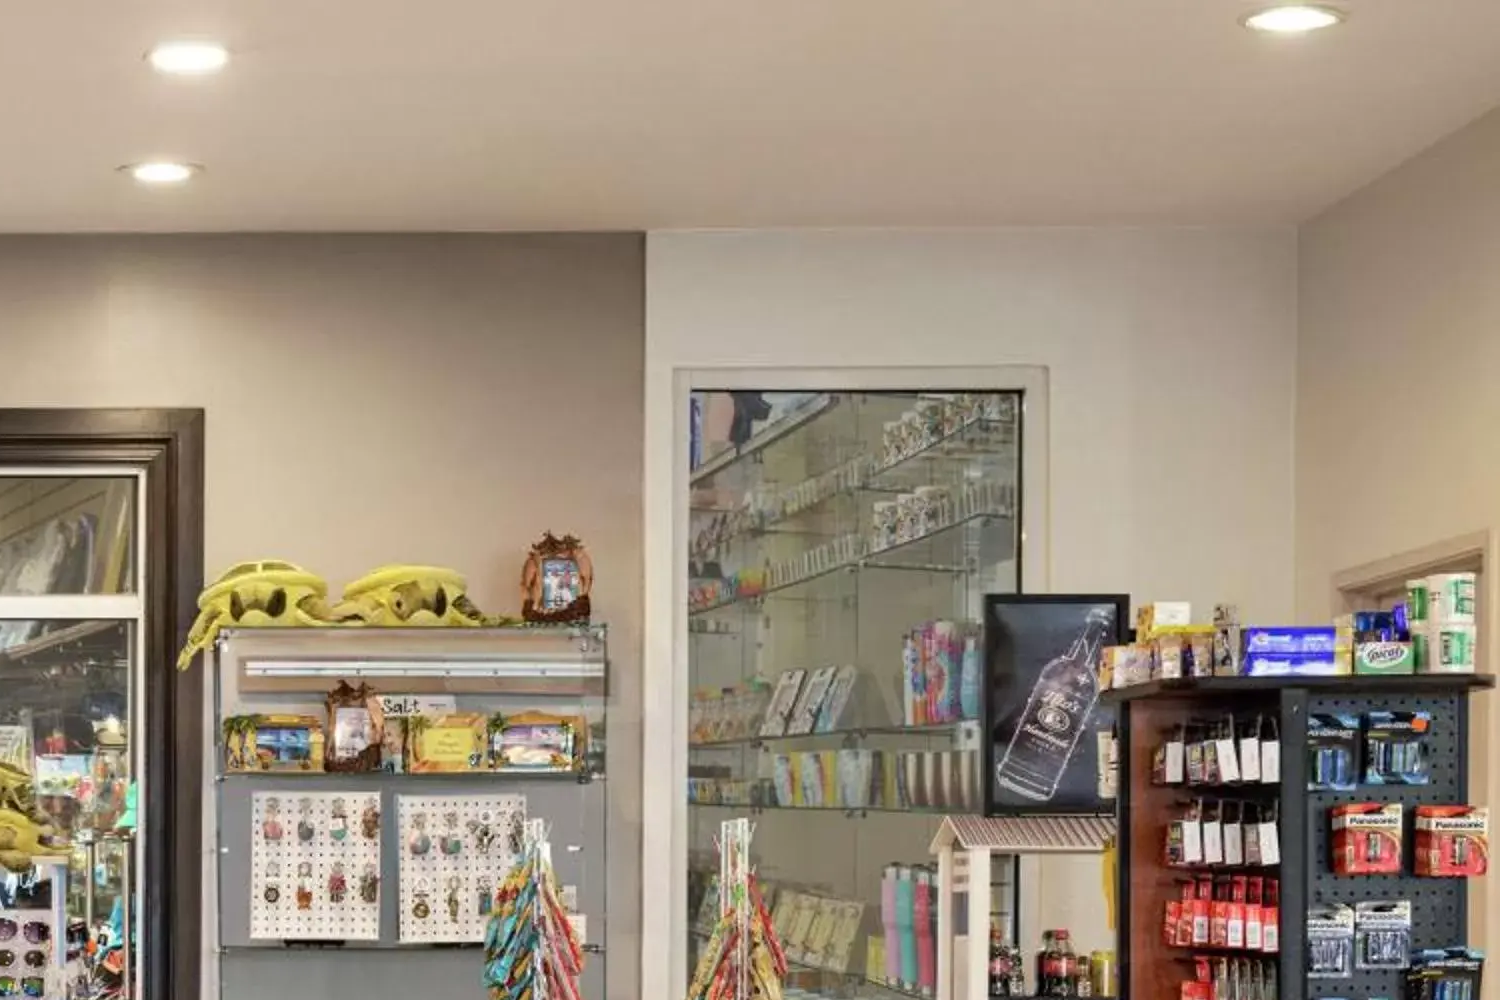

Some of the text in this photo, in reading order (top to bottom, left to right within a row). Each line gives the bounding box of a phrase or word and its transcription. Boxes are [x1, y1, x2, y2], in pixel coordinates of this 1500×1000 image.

[383, 697, 421, 714] Salt
[1348, 816, 1400, 826] Panasonic
[1434, 820, 1485, 830] Panasonic
